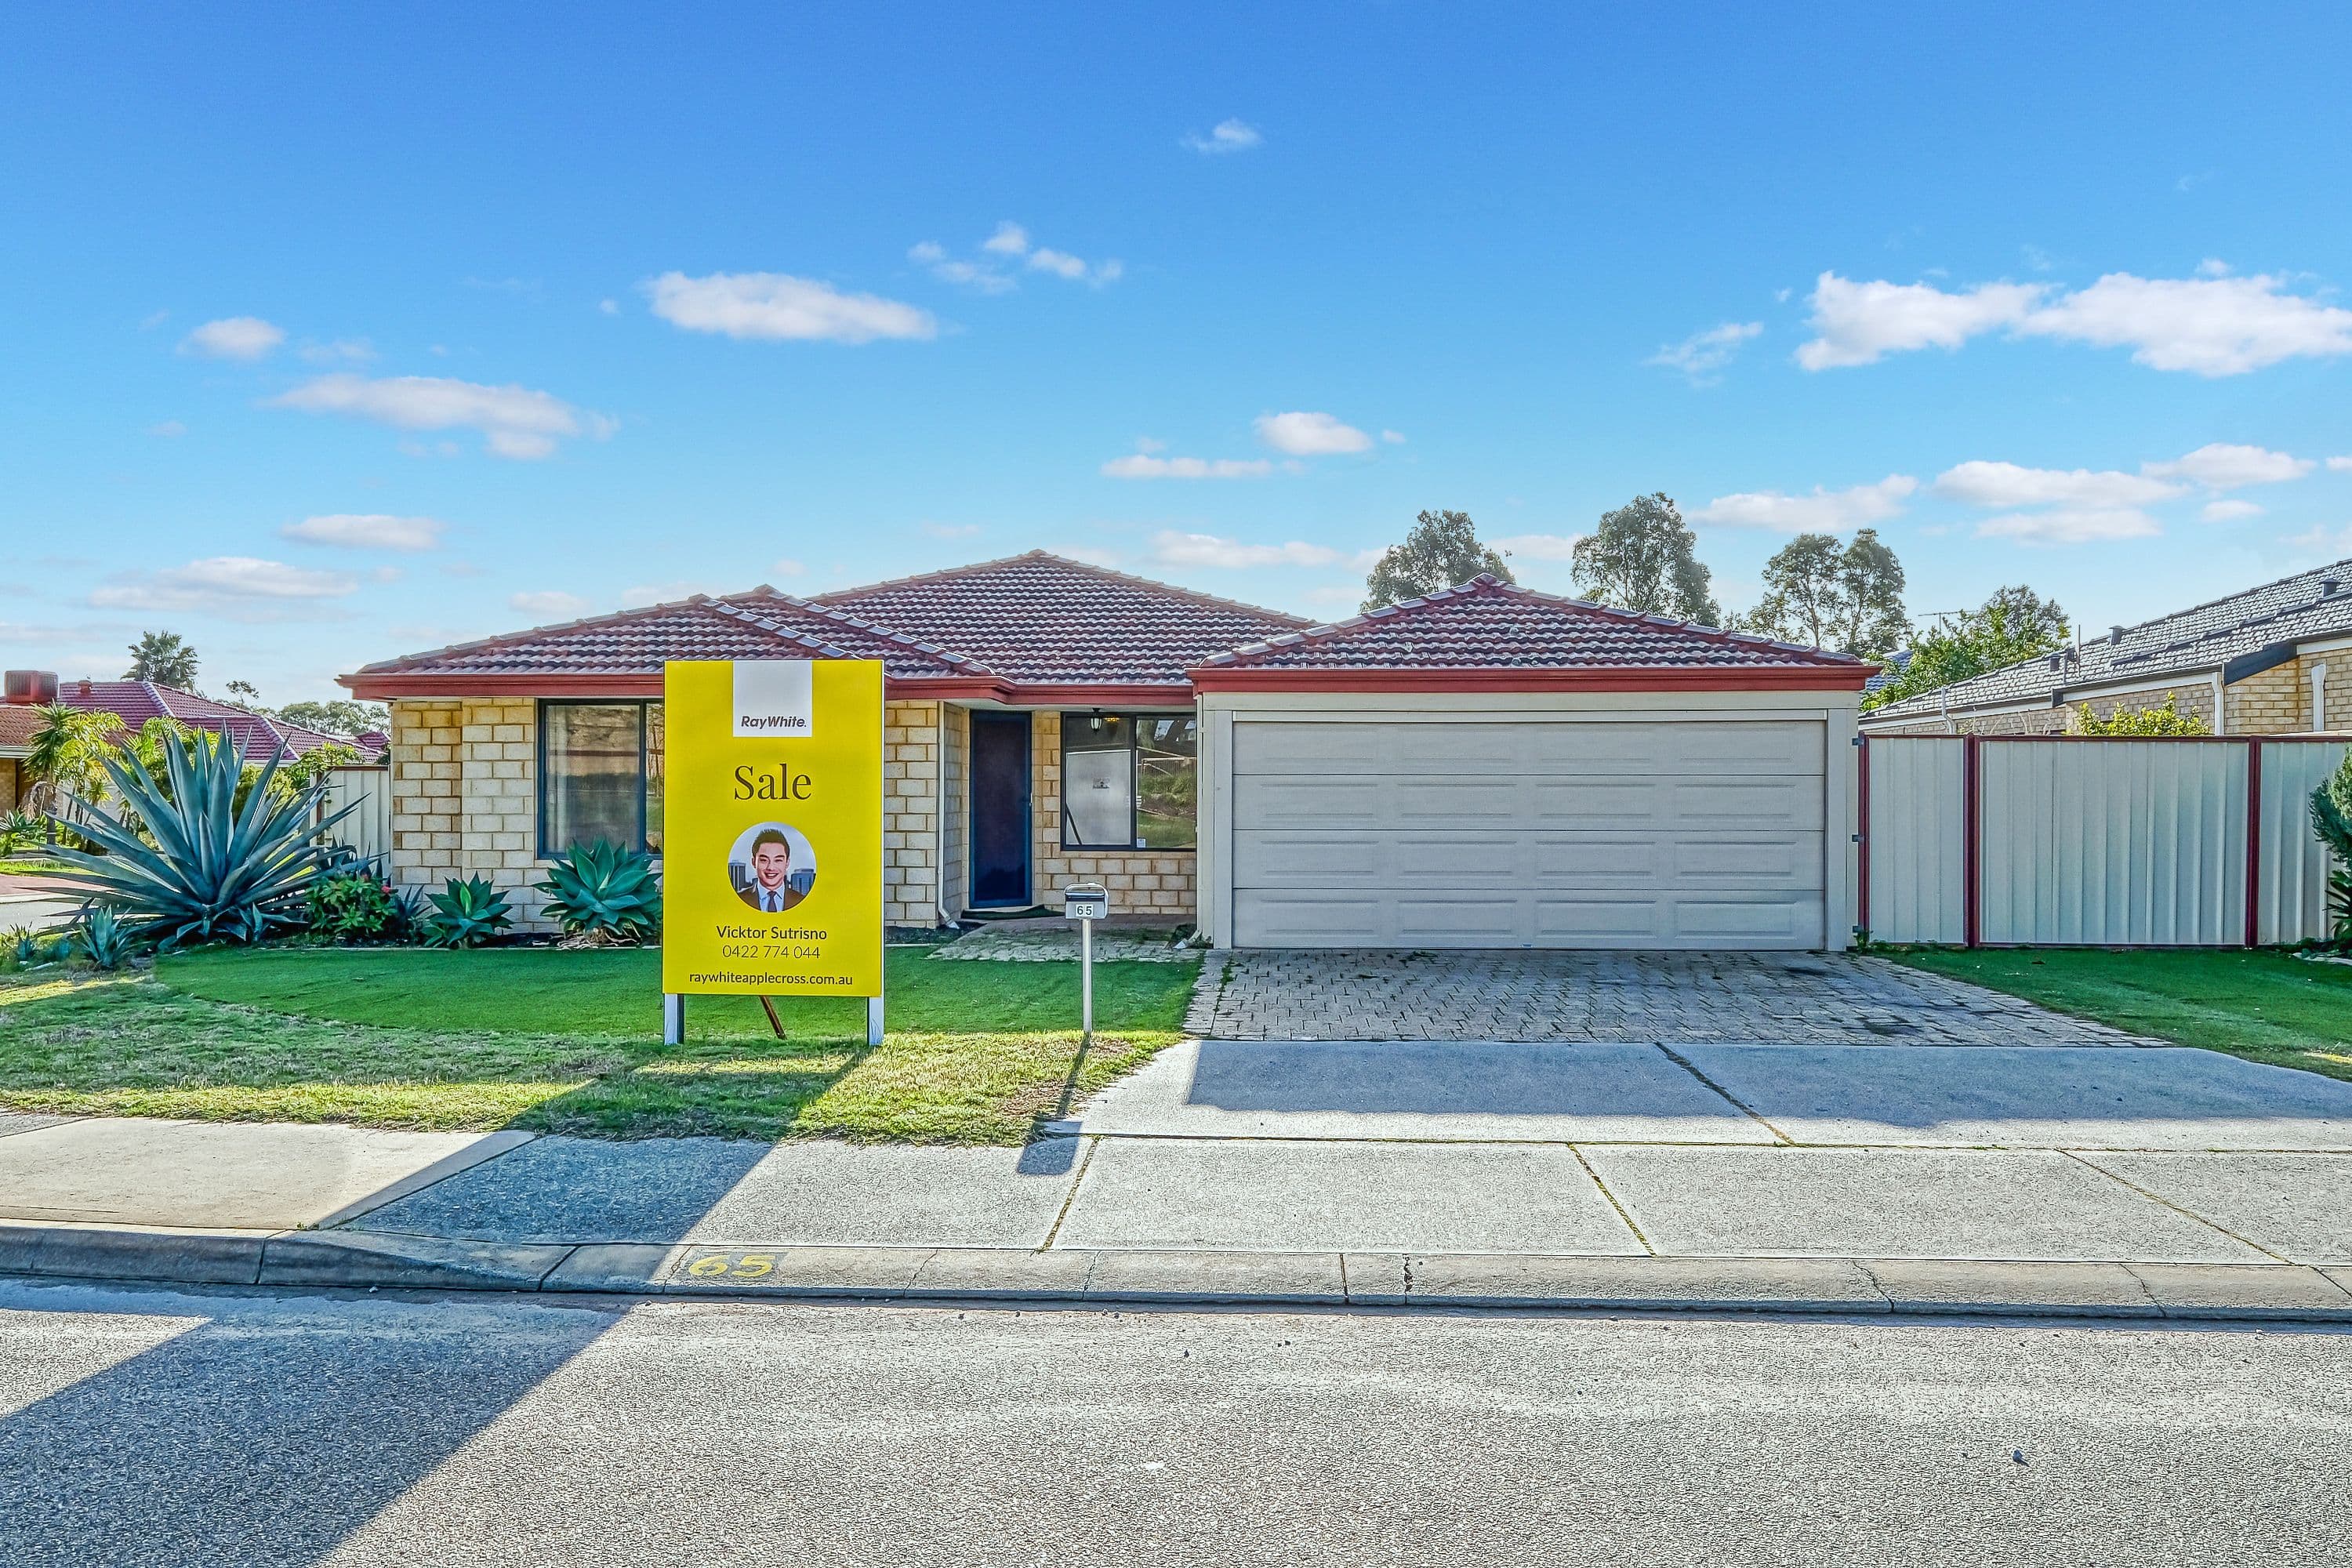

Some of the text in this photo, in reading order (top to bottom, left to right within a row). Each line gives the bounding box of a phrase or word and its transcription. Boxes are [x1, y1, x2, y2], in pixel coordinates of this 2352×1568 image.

[734, 763, 811, 800] Sale
[1076, 906, 1092, 916] 65
[716, 925, 828, 940] Vicktor Sutrisno
[722, 945, 821, 959] 0422 774 044
[689, 971, 853, 985] raywhiteapplecross.com.au
[688, 1254, 776, 1278] 65
